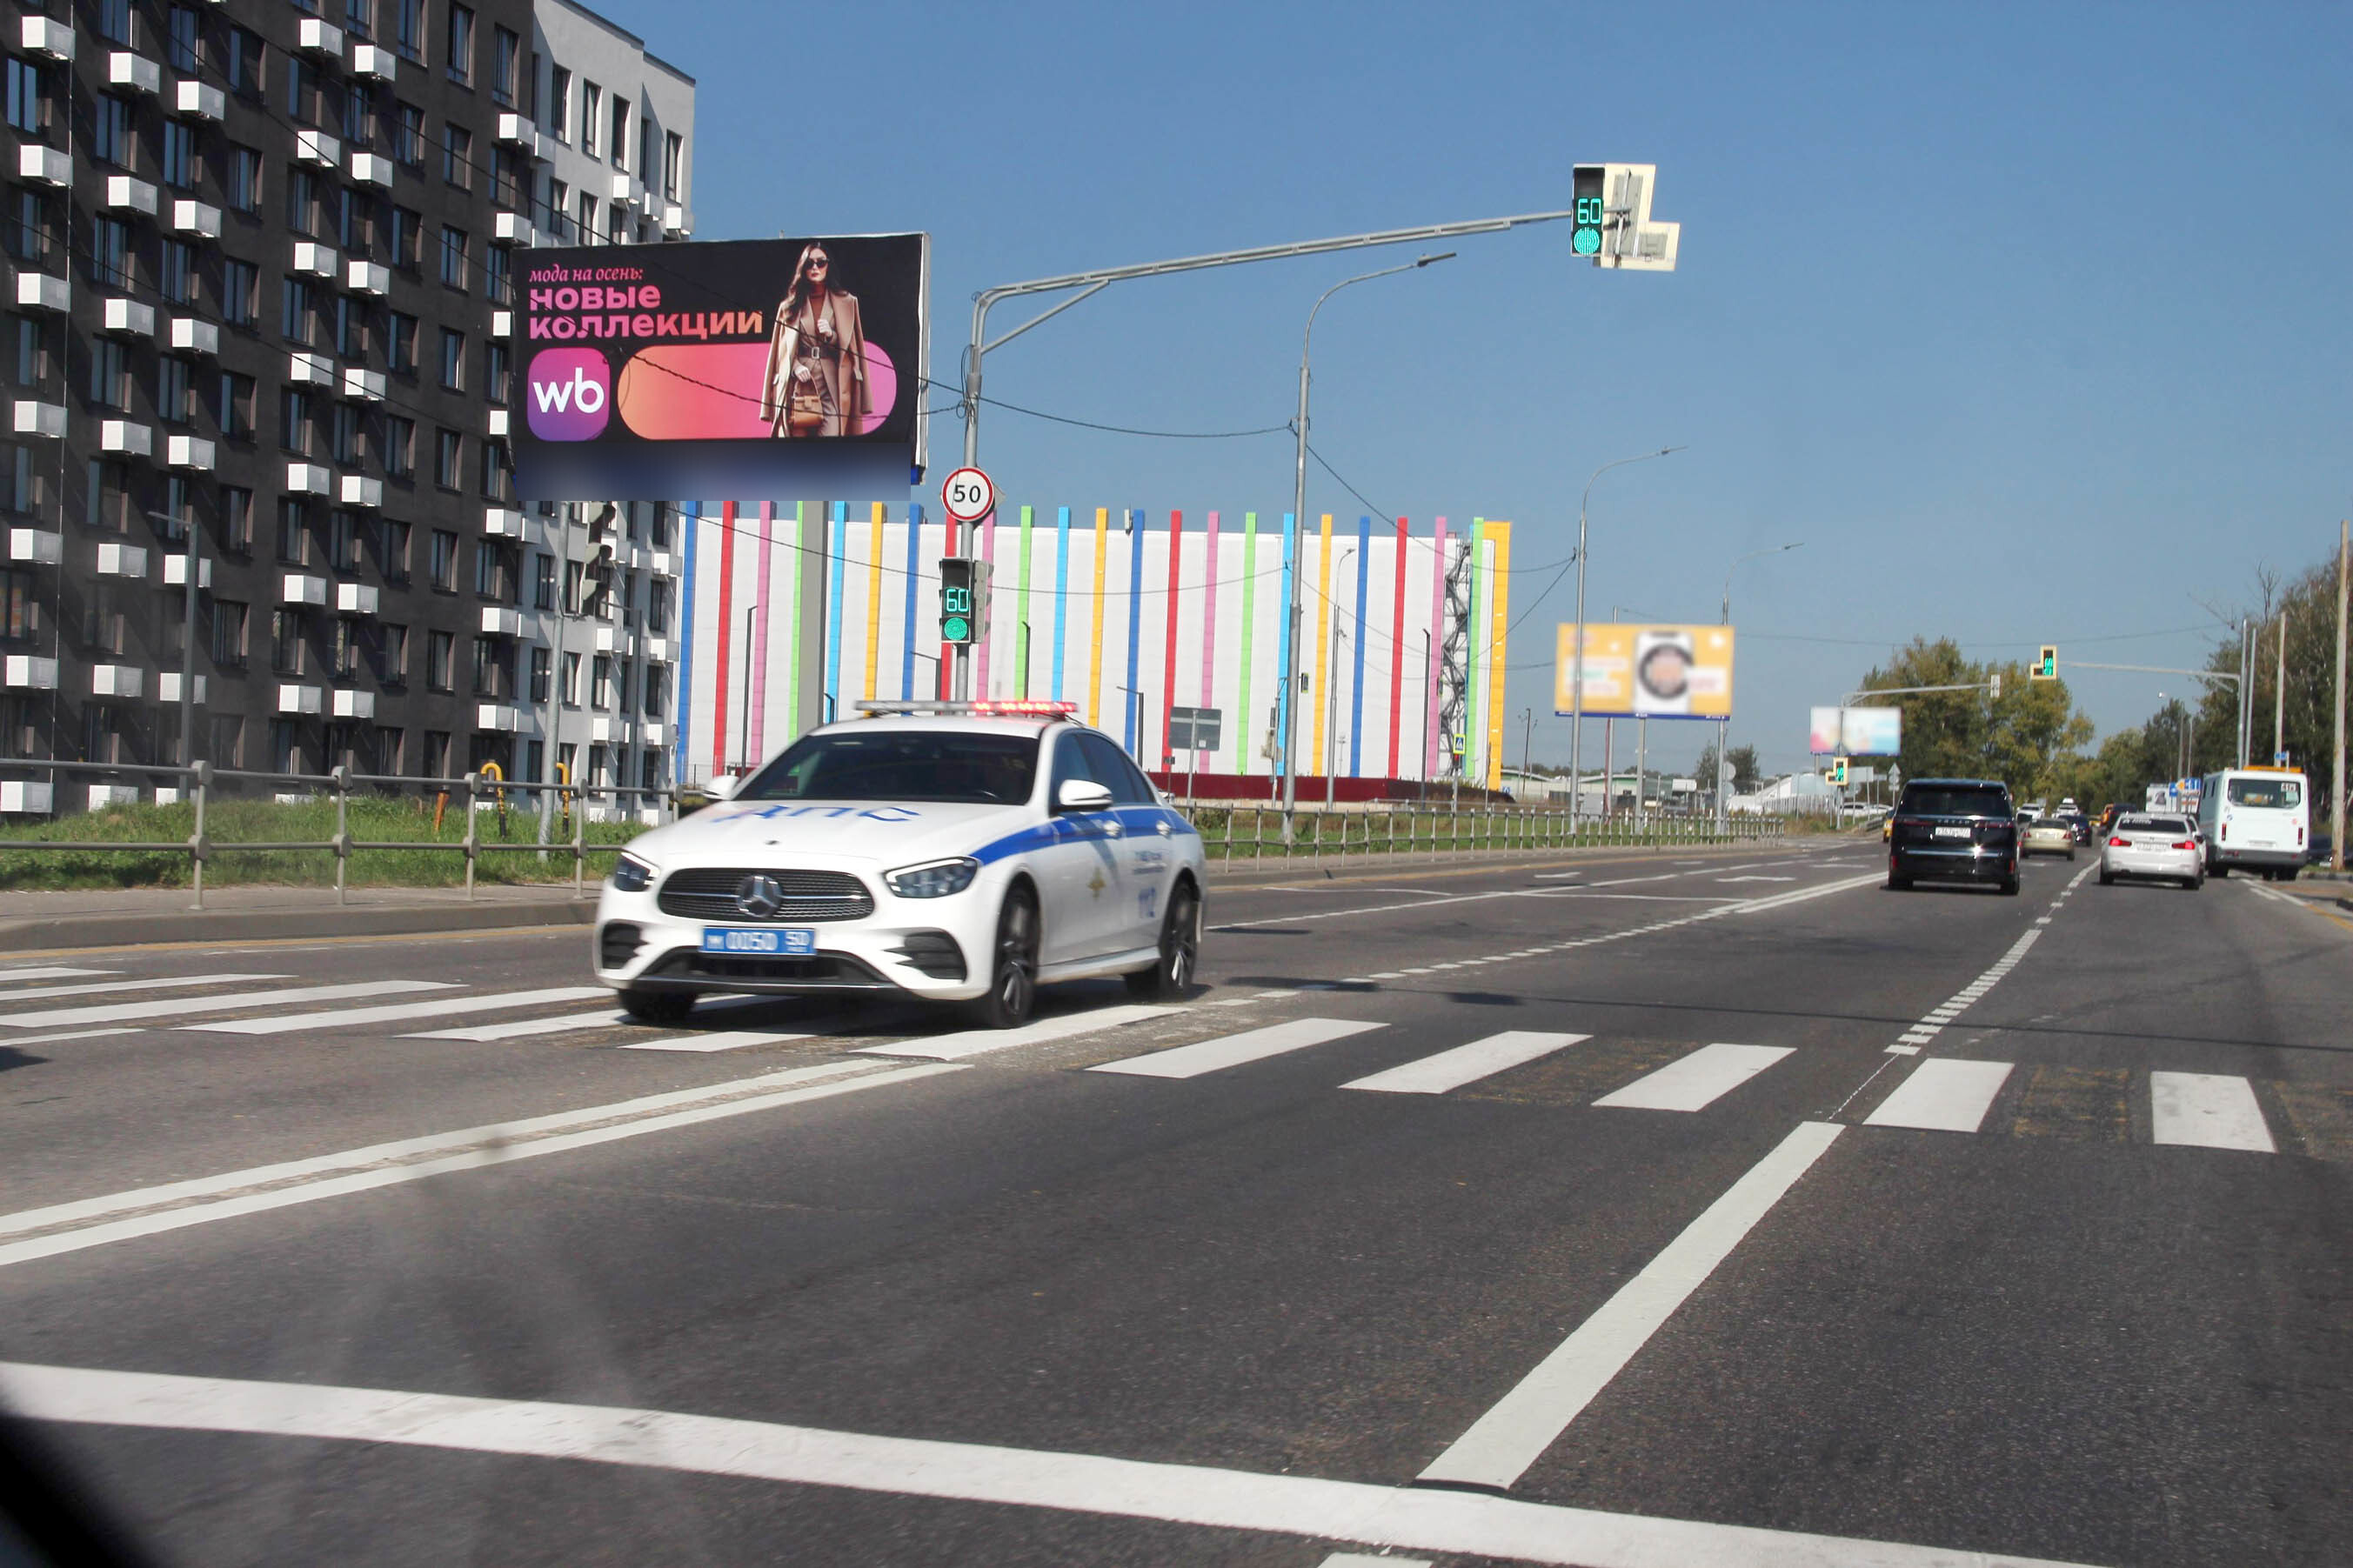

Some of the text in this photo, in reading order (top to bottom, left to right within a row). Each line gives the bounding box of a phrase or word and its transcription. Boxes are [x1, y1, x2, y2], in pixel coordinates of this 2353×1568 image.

[1577, 197, 1601, 224] 60
[529, 264, 644, 283] мода на осень:
[532, 366, 605, 414] wb
[953, 484, 981, 504] 50
[946, 588, 970, 612] 60
